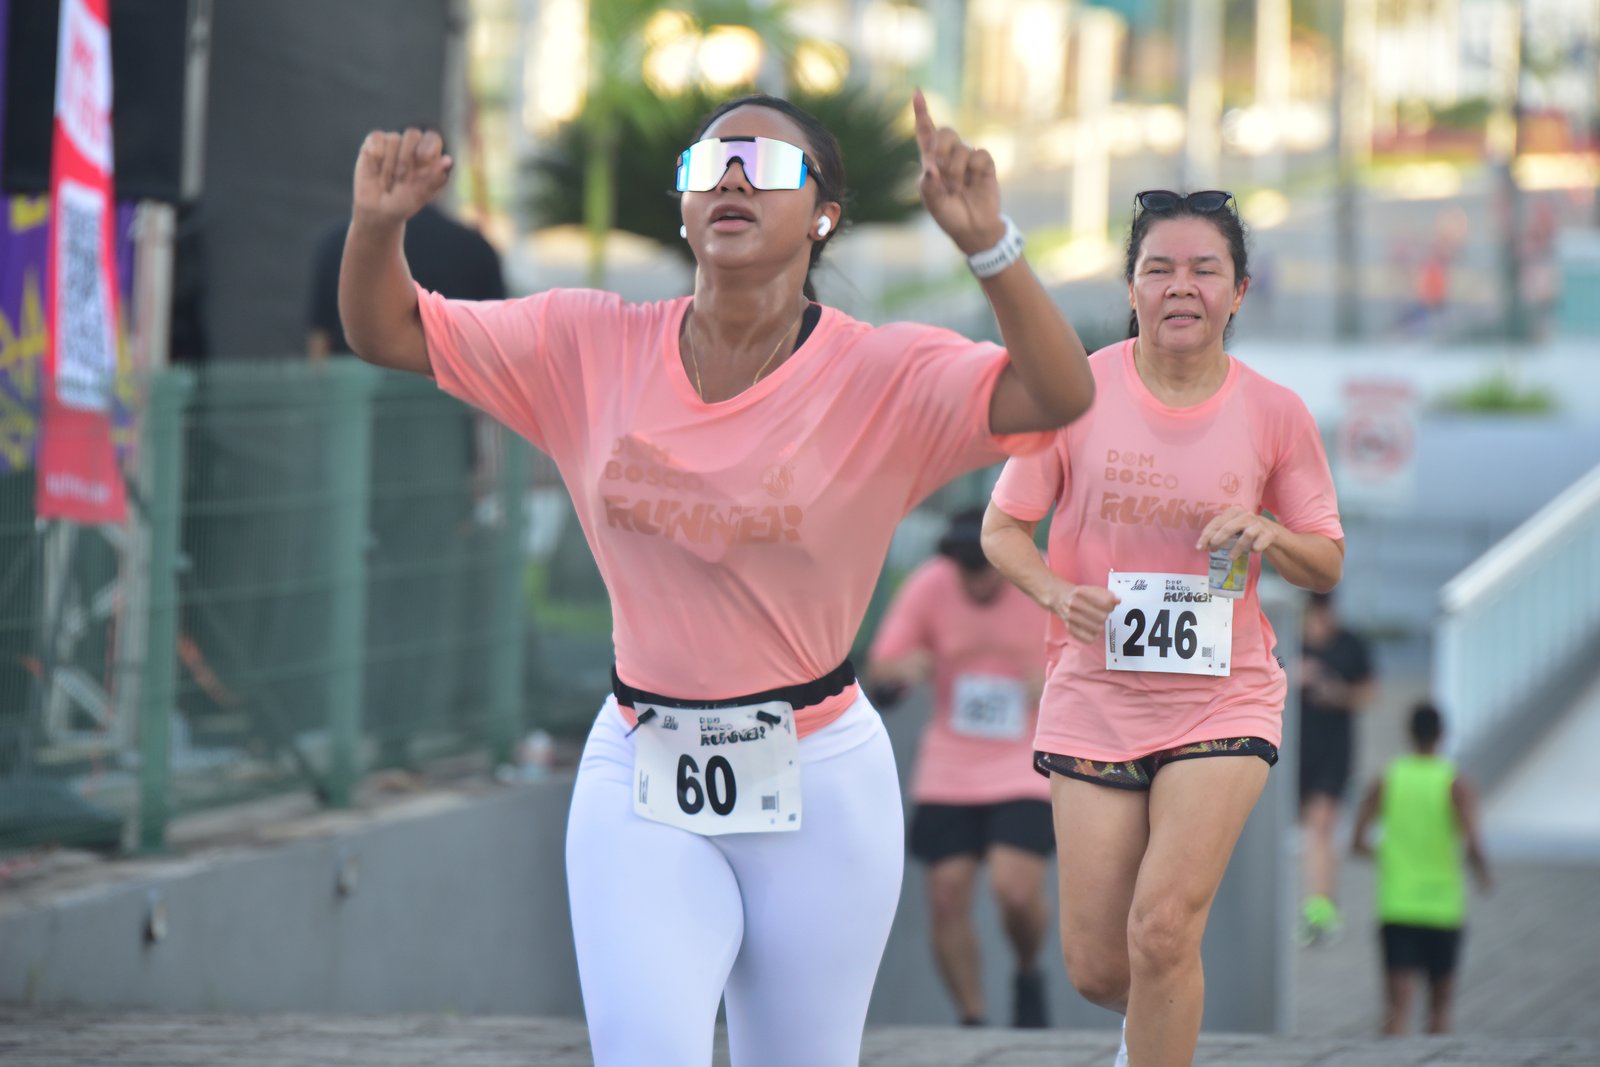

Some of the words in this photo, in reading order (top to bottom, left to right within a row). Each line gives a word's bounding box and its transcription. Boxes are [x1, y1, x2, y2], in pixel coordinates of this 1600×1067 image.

[1106, 449, 1155, 468] DOM
[605, 460, 704, 490] BOSCO
[1104, 467, 1179, 490] BOSCO
[1122, 608, 1198, 660] 246
[676, 753, 737, 816] 60
